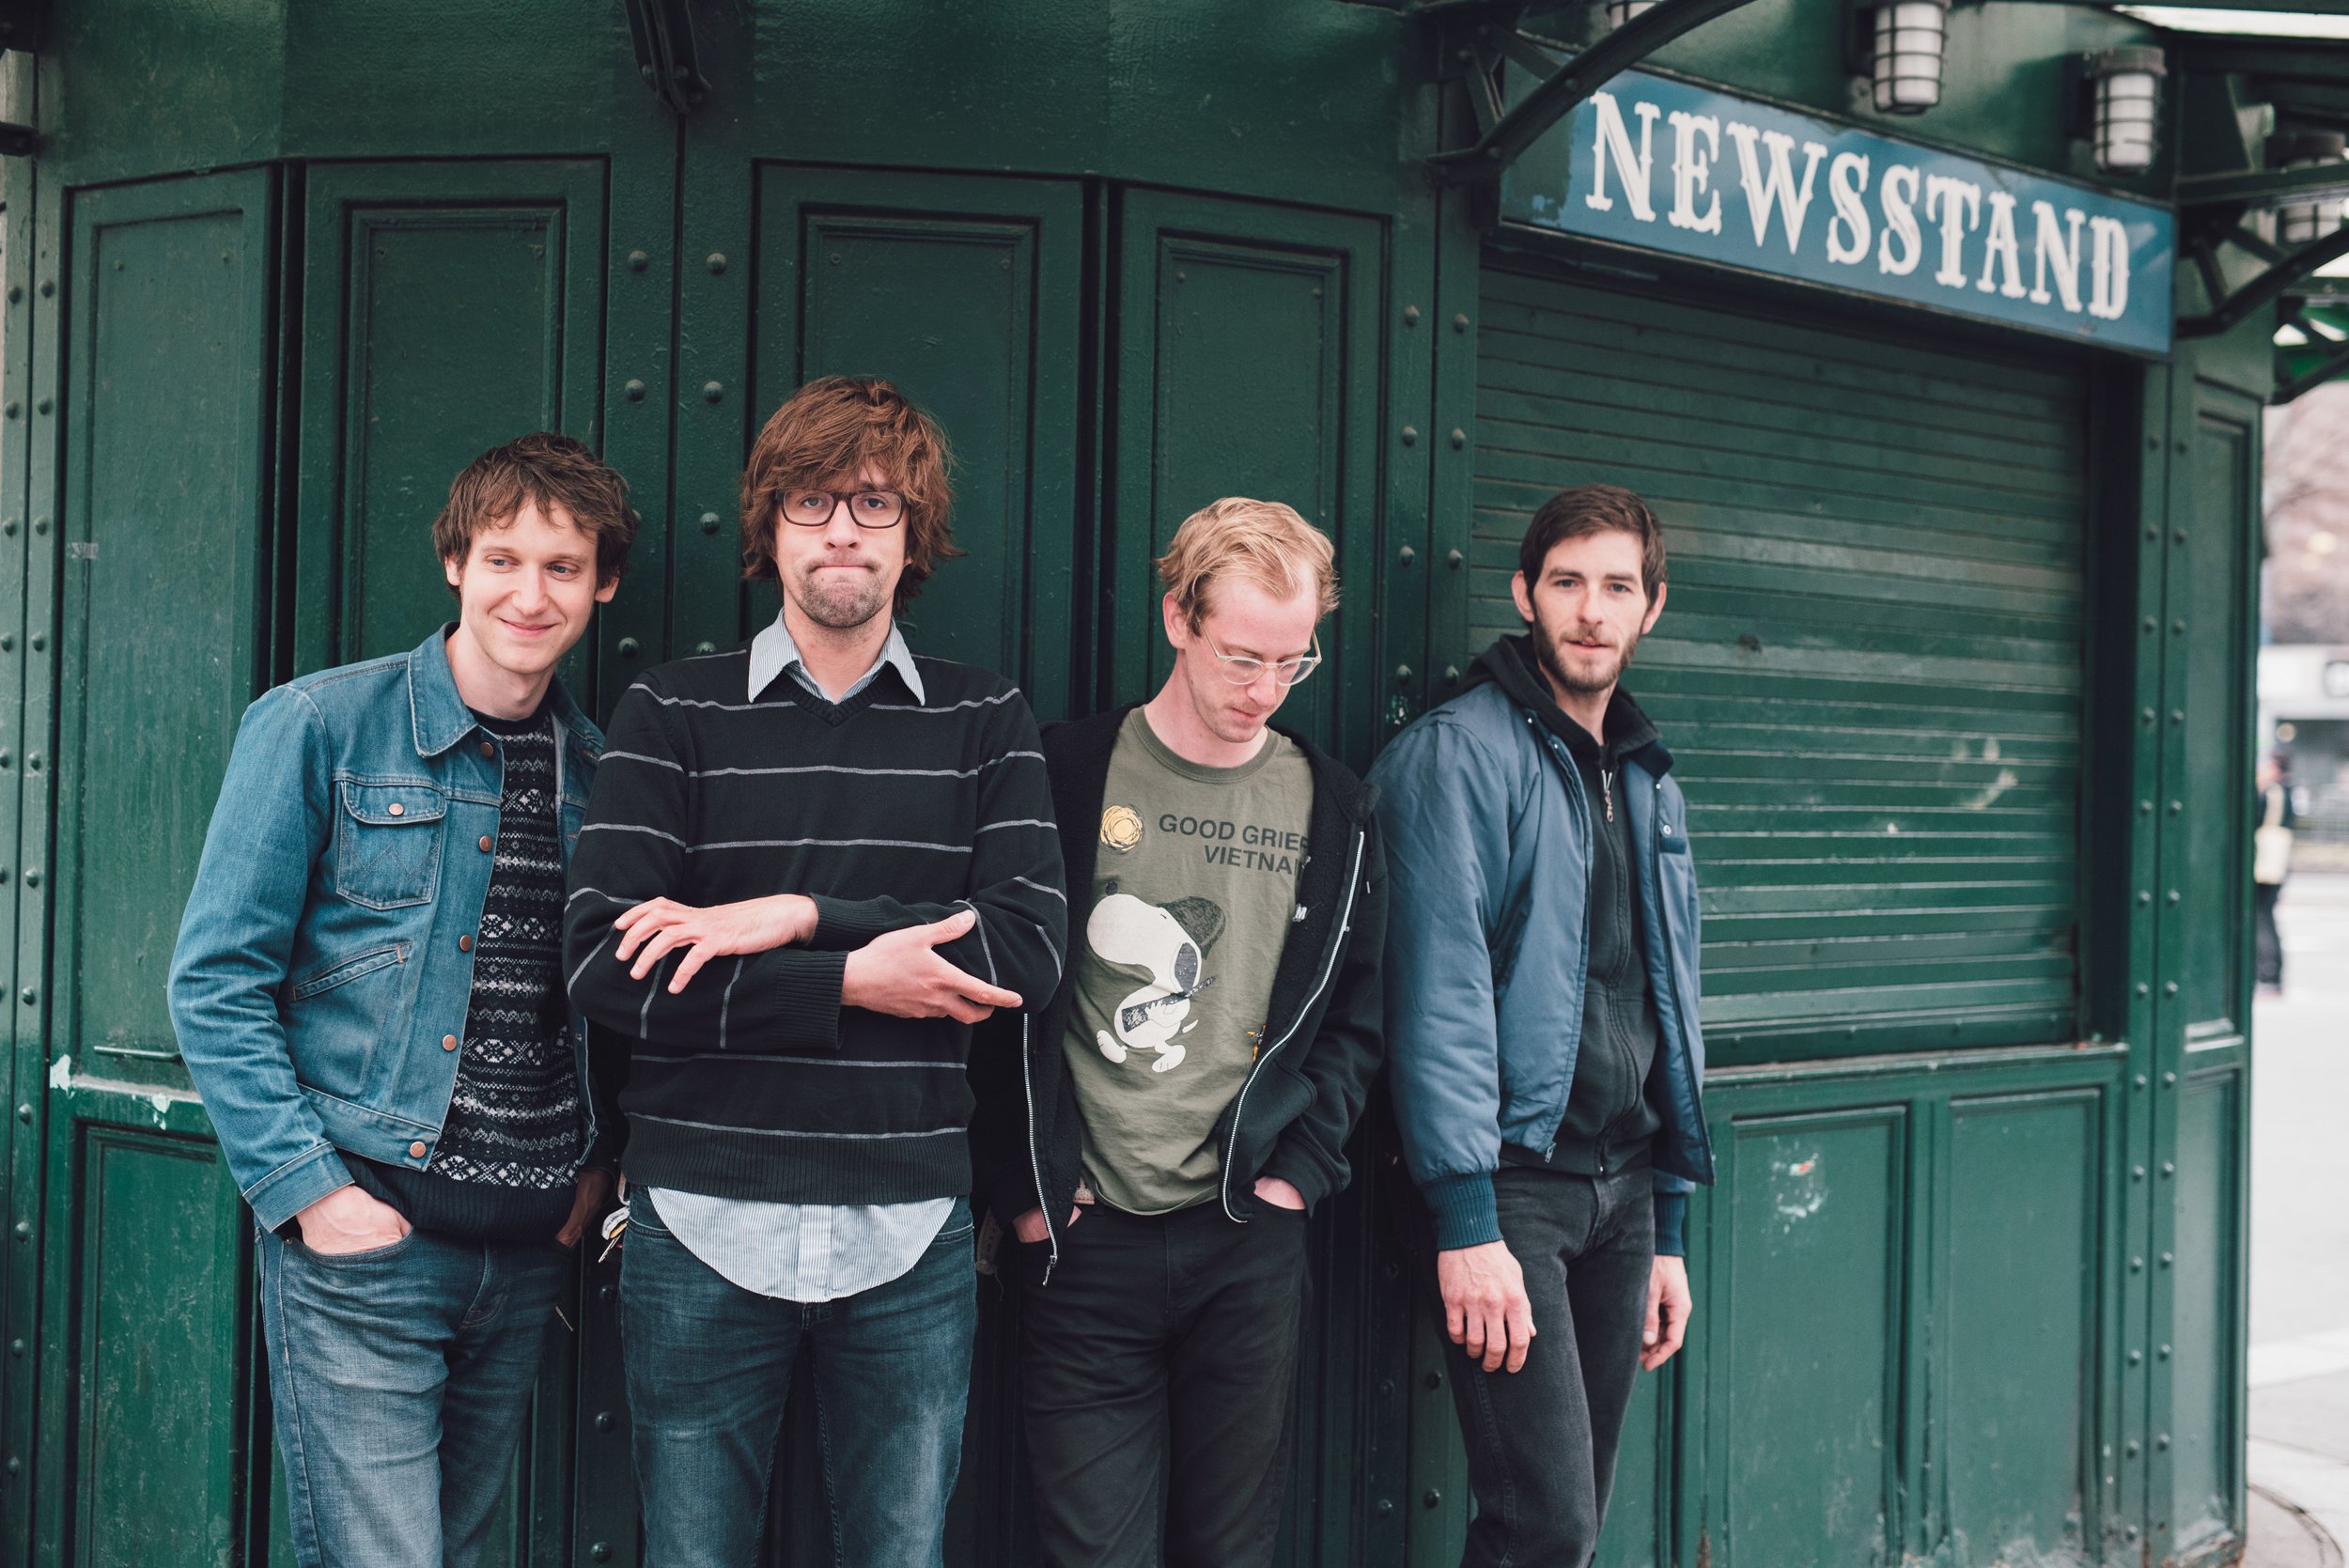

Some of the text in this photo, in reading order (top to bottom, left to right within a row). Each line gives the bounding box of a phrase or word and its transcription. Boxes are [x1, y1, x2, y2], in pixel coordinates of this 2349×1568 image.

[1585, 89, 2130, 320] NEWSSTAND
[1159, 814, 1236, 840] GOOD
[1204, 845, 1299, 877] VIETNA
